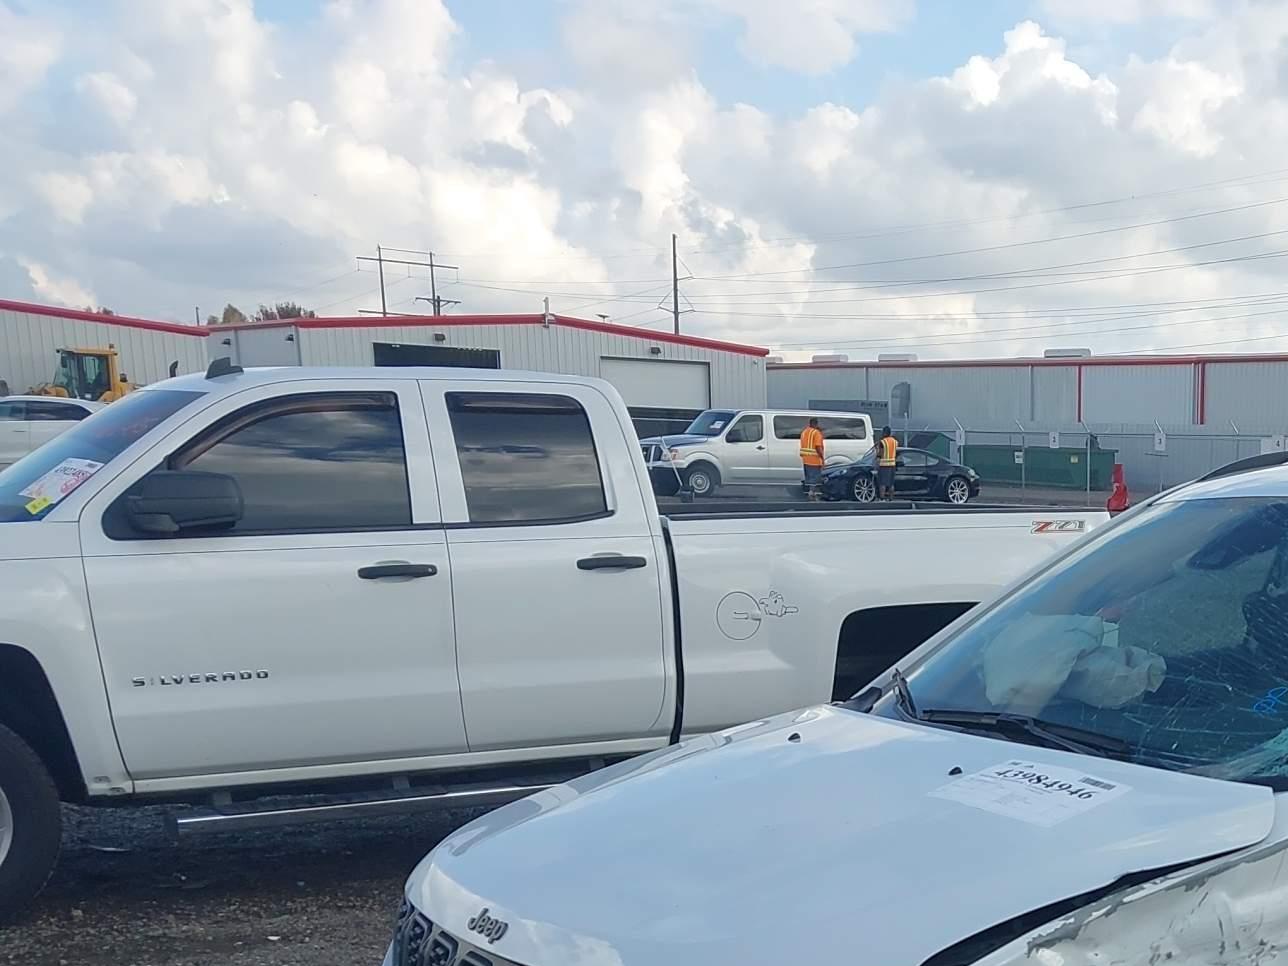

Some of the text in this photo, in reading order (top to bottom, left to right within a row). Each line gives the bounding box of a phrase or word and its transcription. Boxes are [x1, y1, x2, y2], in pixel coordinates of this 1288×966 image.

[1031, 520, 1085, 534] Z71
[132, 669, 269, 687] SILVERADO
[995, 768, 1095, 800] 43984946
[467, 907, 508, 944] Jeep
